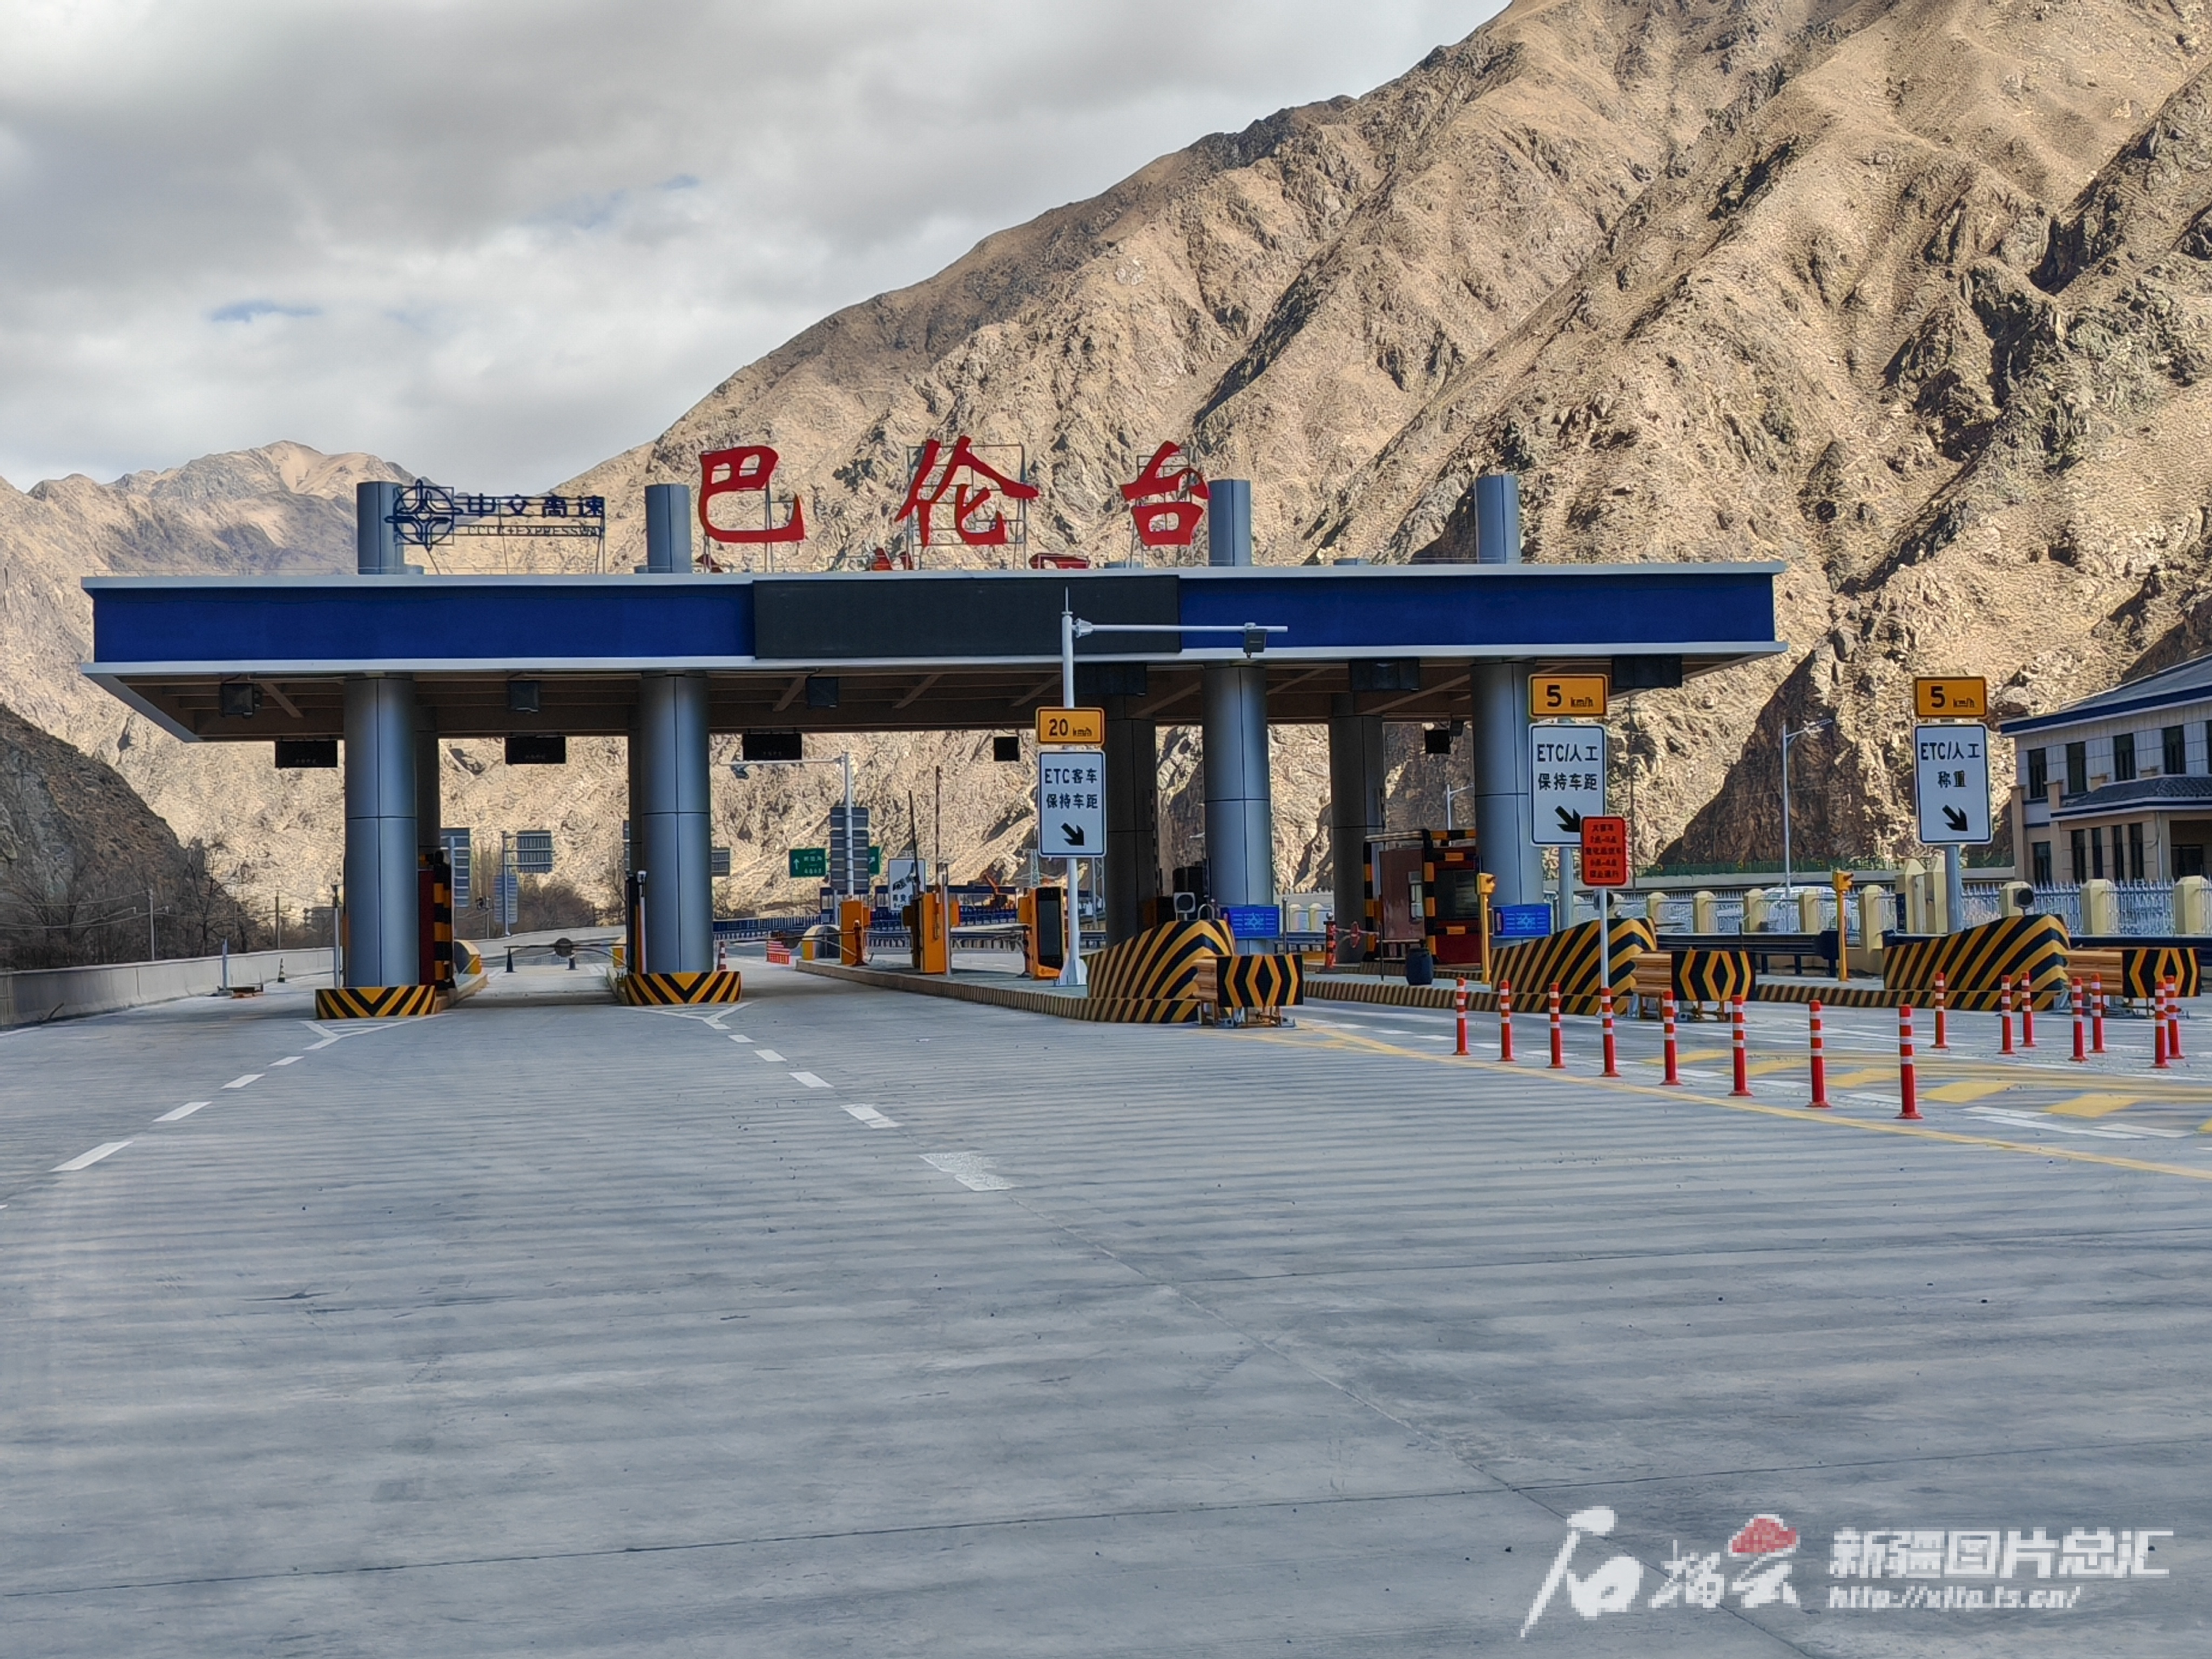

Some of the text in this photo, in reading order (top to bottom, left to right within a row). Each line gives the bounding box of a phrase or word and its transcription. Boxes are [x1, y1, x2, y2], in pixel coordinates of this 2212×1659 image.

[698, 435, 1210, 547] 巴伦台
[1546, 684, 1594, 707] 5 km/h
[1930, 685, 1975, 709] 5 km/h
[1048, 718, 1092, 737] 20 km/h
[1536, 743, 1599, 763] ETC/人工
[1920, 740, 1981, 760] ETC/人工
[1044, 767, 1097, 785] ETC客车
[1537, 772, 1598, 791] 保持车距
[1937, 770, 1967, 788] 称重
[1046, 792, 1098, 809] 保持车距
